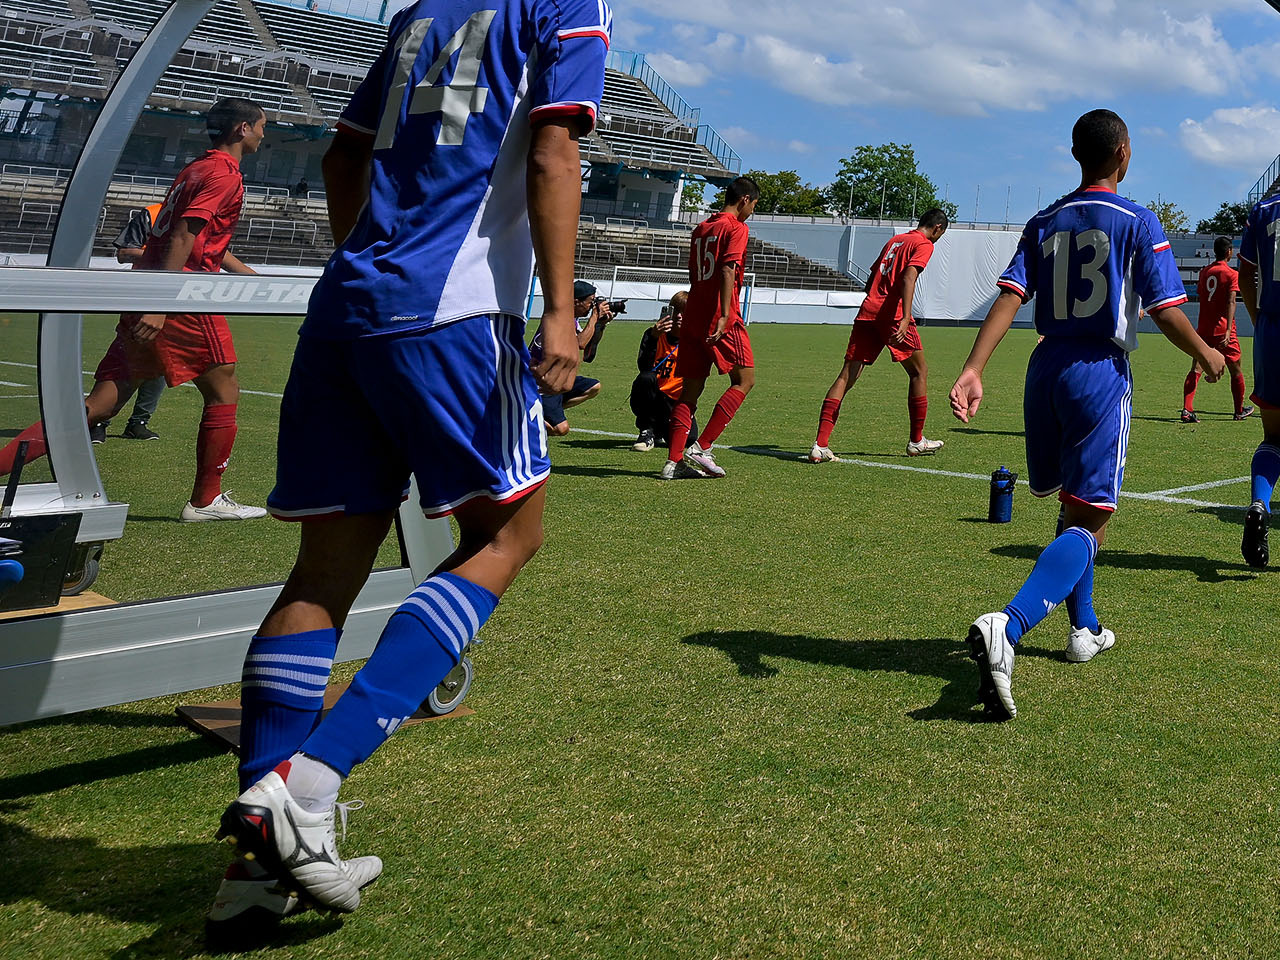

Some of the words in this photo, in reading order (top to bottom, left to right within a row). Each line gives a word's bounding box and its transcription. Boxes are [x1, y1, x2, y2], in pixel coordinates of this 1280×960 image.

[373, 9, 498, 150] 14
[694, 235, 718, 281] 15
[879, 241, 904, 276] 5
[1041, 229, 1110, 320] 13
[1206, 275, 1218, 302] 9
